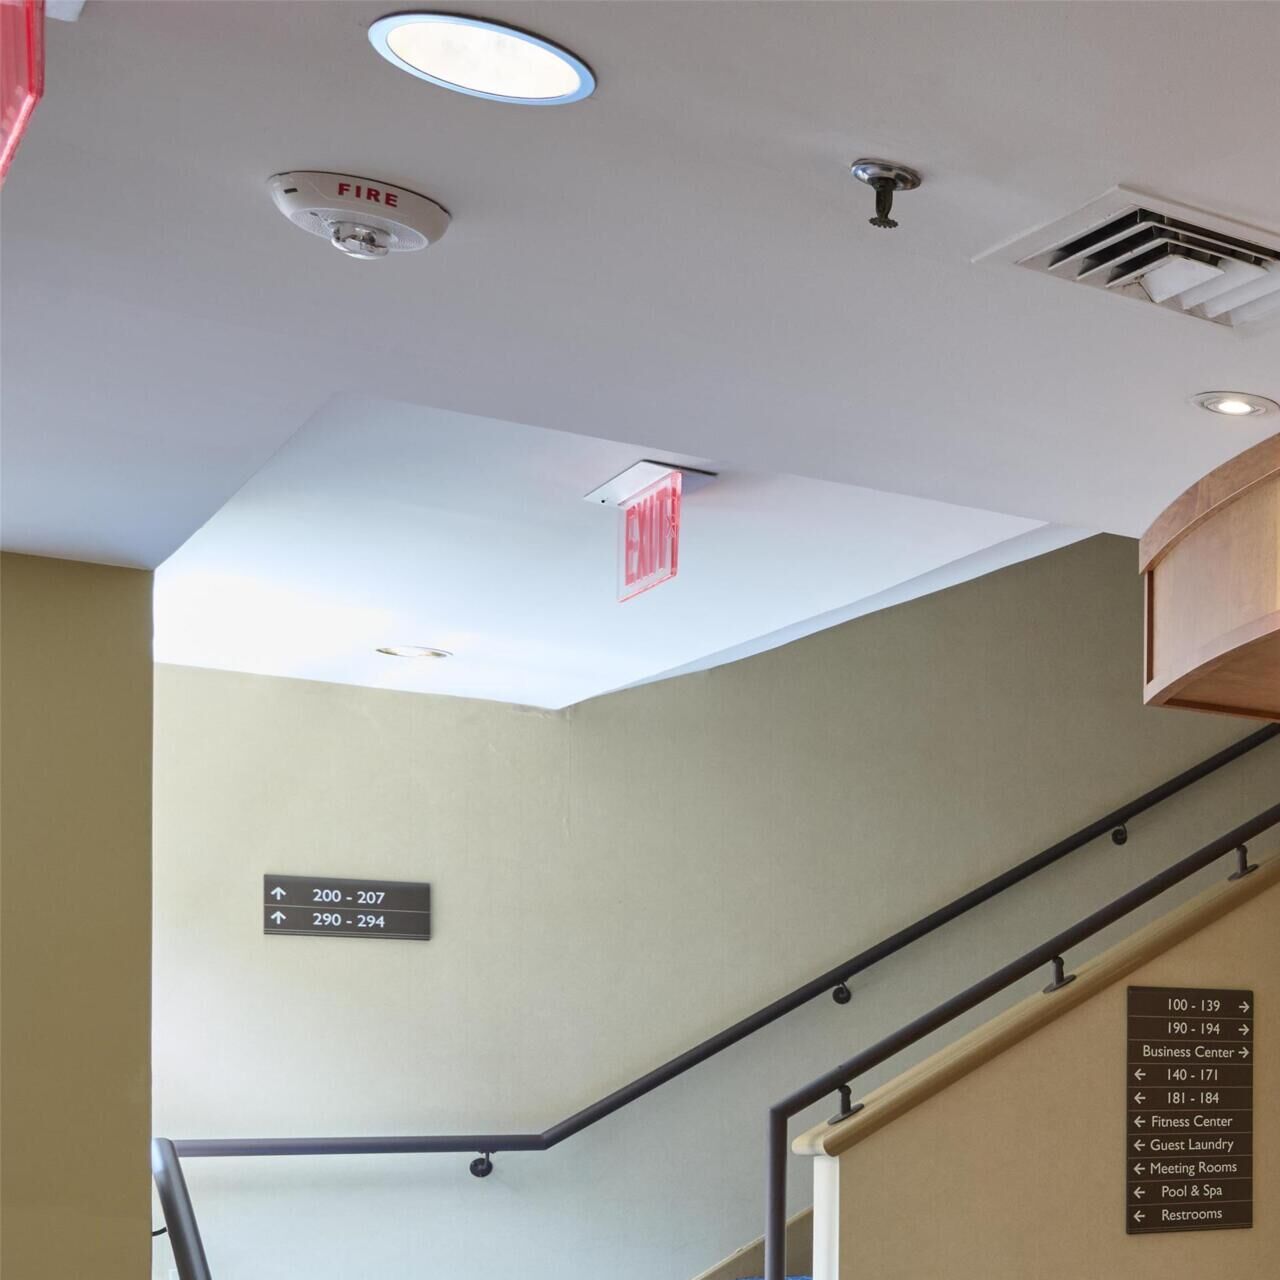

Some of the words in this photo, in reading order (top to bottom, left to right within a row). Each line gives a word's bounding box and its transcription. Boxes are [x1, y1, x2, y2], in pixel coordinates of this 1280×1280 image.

[338, 182, 399, 208] FIRE
[625, 487, 668, 586] EXIT
[312, 889, 342, 902] 200
[356, 892, 386, 904] 207
[312, 913, 342, 926] 290
[356, 915, 386, 928] 294
[1167, 999, 1188, 1011] 100
[1200, 1000, 1221, 1012] 139
[1167, 1022, 1188, 1034] 190
[1200, 1023, 1221, 1035] 194
[1143, 1045, 1191, 1058] Business
[1194, 1046, 1235, 1058] Center
[1167, 1069, 1187, 1081] 140
[1200, 1069, 1218, 1081] 171
[1167, 1092, 1186, 1104] 181
[1200, 1092, 1220, 1104] 184
[1151, 1116, 1190, 1128] Fitness
[1193, 1115, 1233, 1127] Center
[1150, 1139, 1185, 1151] Guest
[1188, 1138, 1234, 1152] Laundry
[1150, 1163, 1196, 1177] Meeting
[1198, 1161, 1238, 1174] Rooms
[1161, 1185, 1187, 1198] Pool
[1190, 1185, 1200, 1197] &
[1203, 1184, 1223, 1199] Spa
[1161, 1208, 1223, 1221] Restrooms
